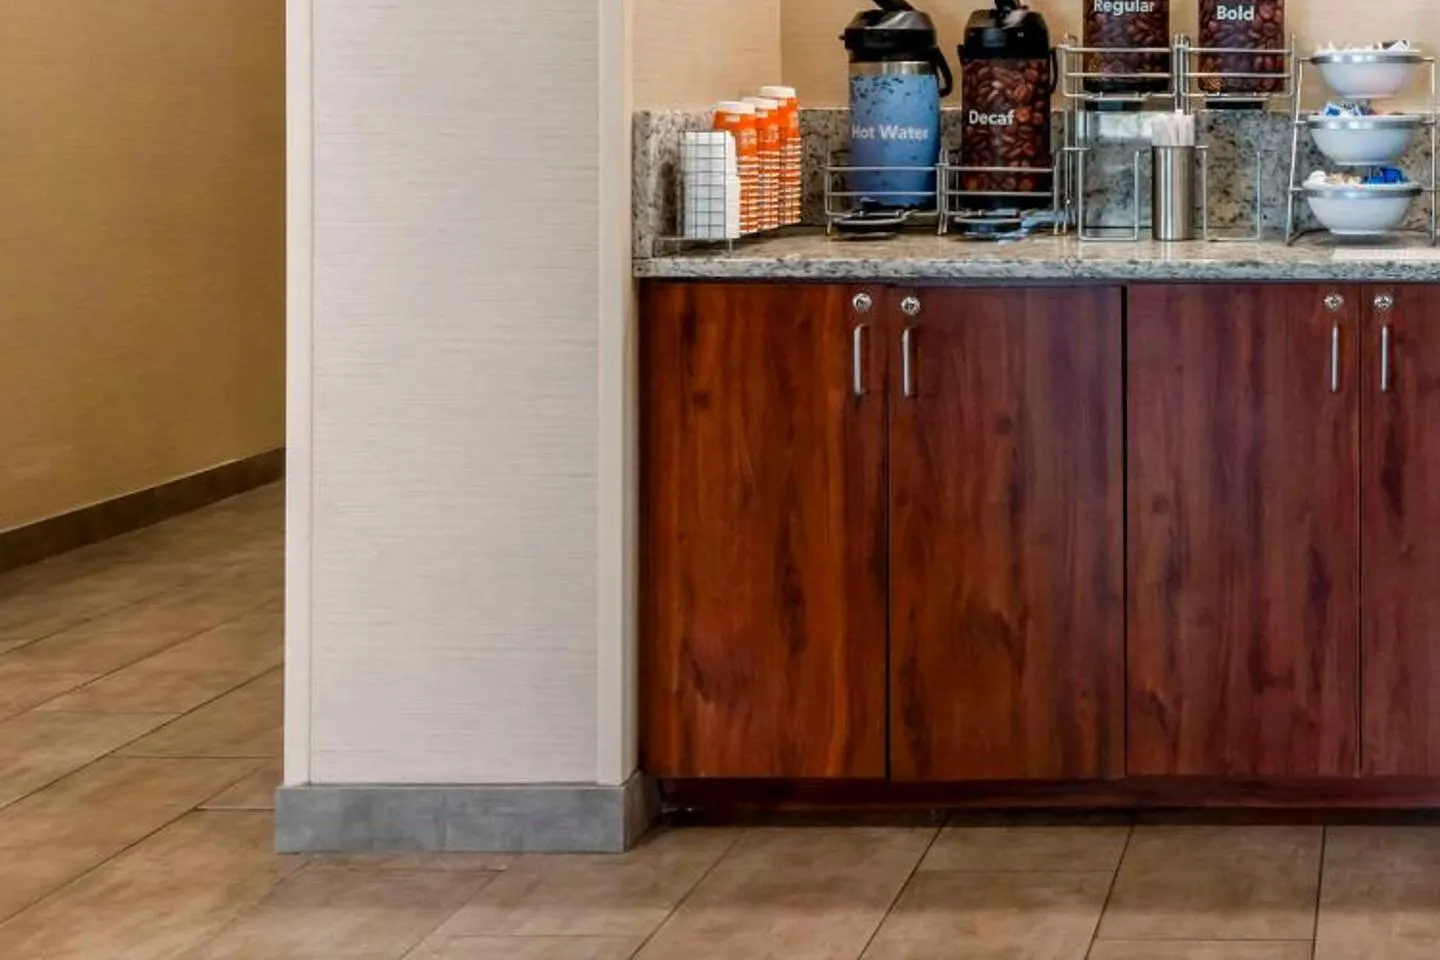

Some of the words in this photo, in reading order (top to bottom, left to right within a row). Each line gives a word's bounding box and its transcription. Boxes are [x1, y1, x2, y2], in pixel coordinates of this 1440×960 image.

[1216, 5, 1255, 20] Bold
[968, 109, 1015, 125] Decaf
[851, 125, 874, 139] Hot
[879, 124, 929, 140] Water
